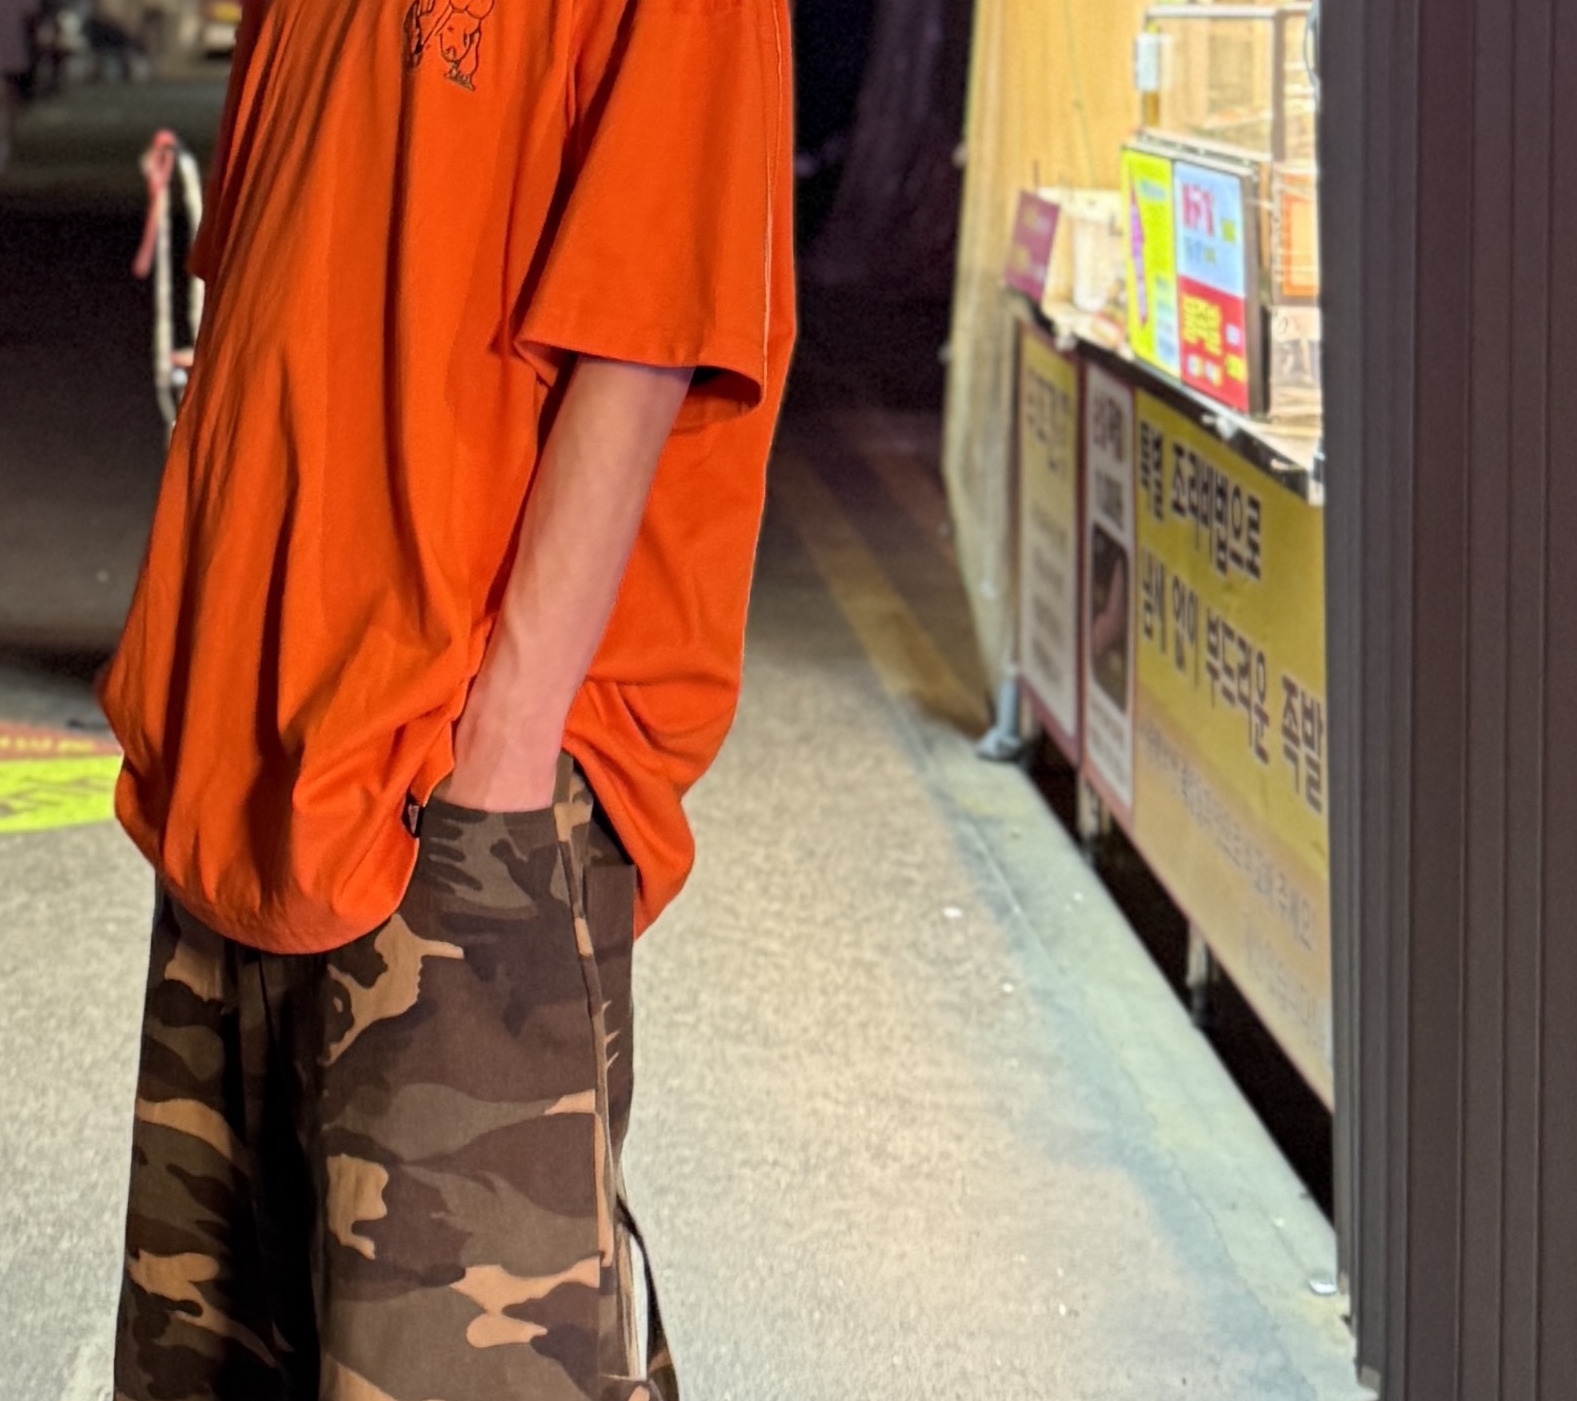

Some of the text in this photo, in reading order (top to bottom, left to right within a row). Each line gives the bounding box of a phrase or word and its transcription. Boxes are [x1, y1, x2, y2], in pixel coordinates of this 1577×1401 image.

[1172, 573, 1199, 689] 없이
[1205, 606, 1270, 767] 부드러운
[1281, 673, 1323, 814] 족발
